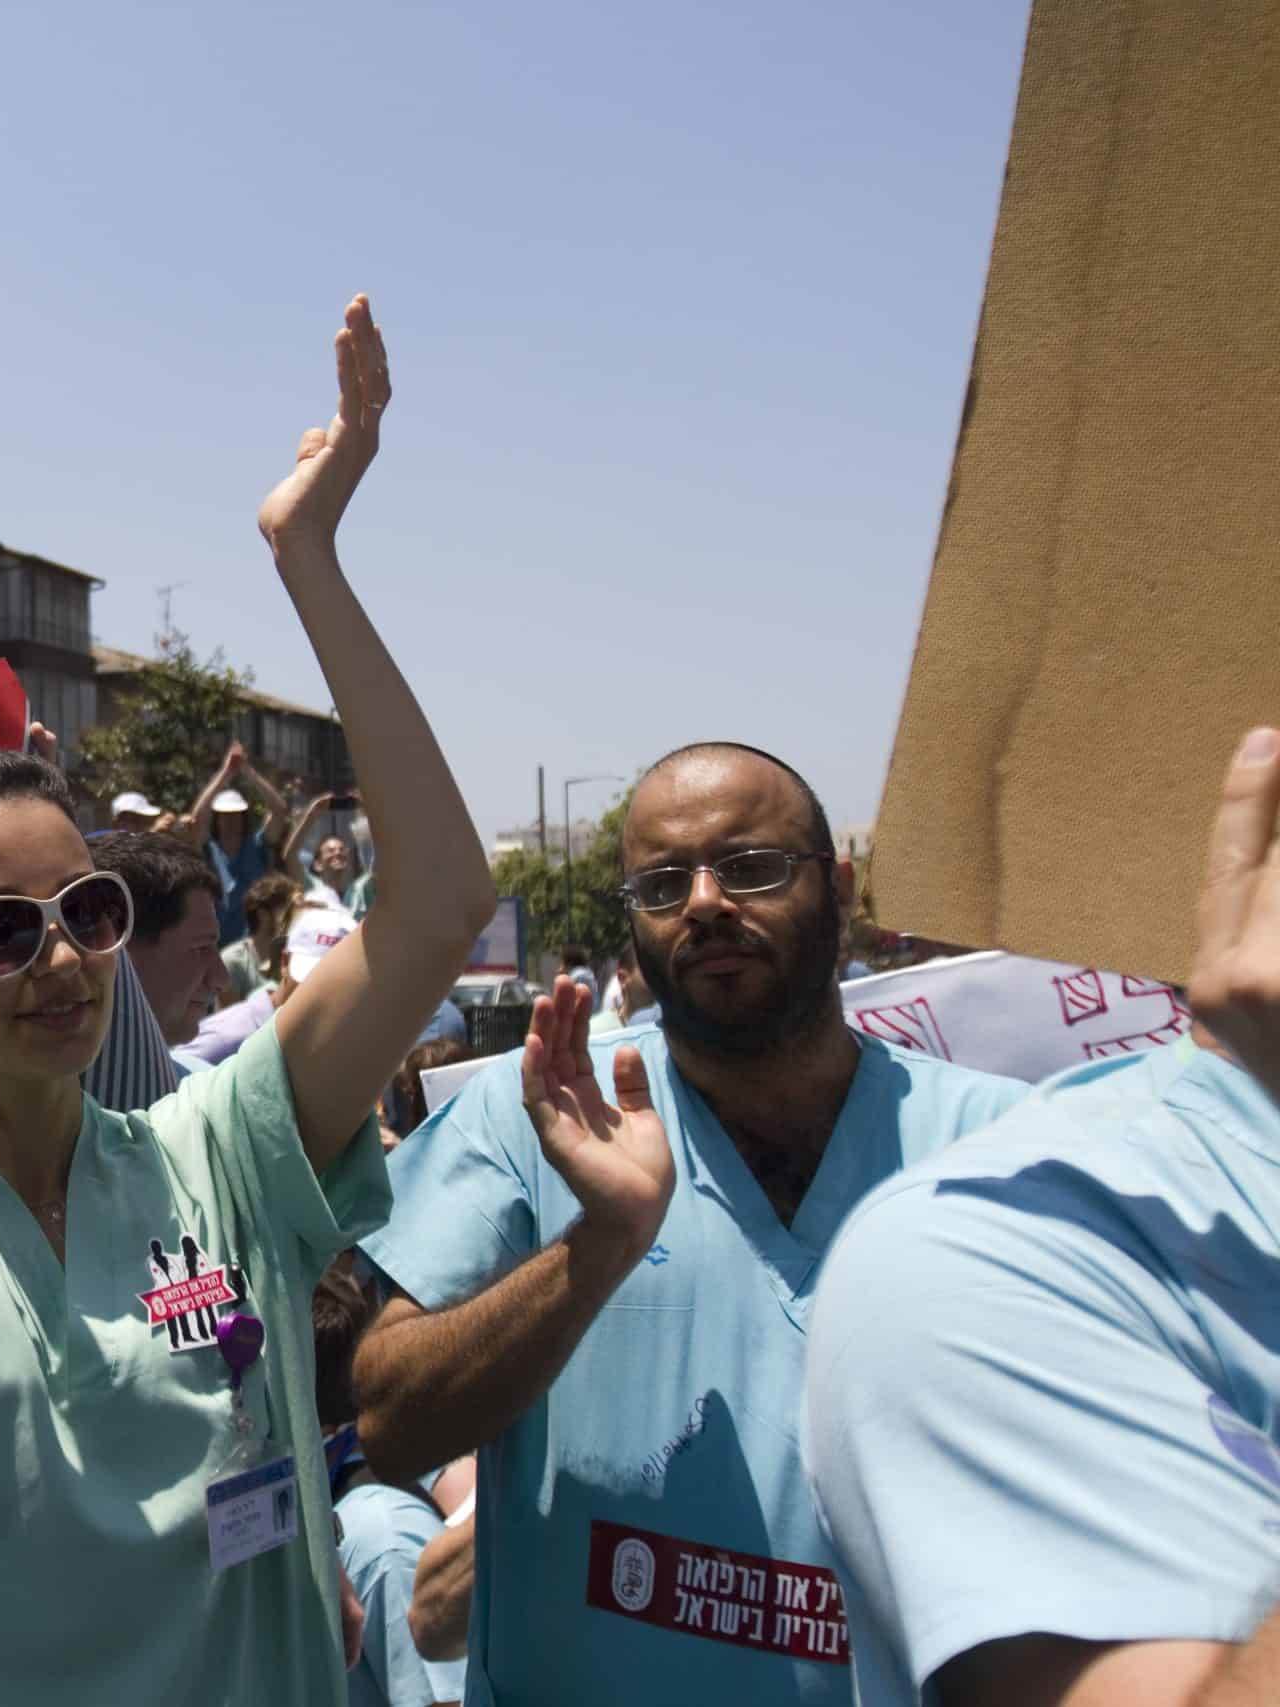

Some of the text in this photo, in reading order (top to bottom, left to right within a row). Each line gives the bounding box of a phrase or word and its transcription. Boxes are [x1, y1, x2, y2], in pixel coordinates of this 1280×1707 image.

[676, 1552, 767, 1603] הרפואה
[774, 1573, 811, 1611] את
[673, 1587, 850, 1656] יבורית בישראל
